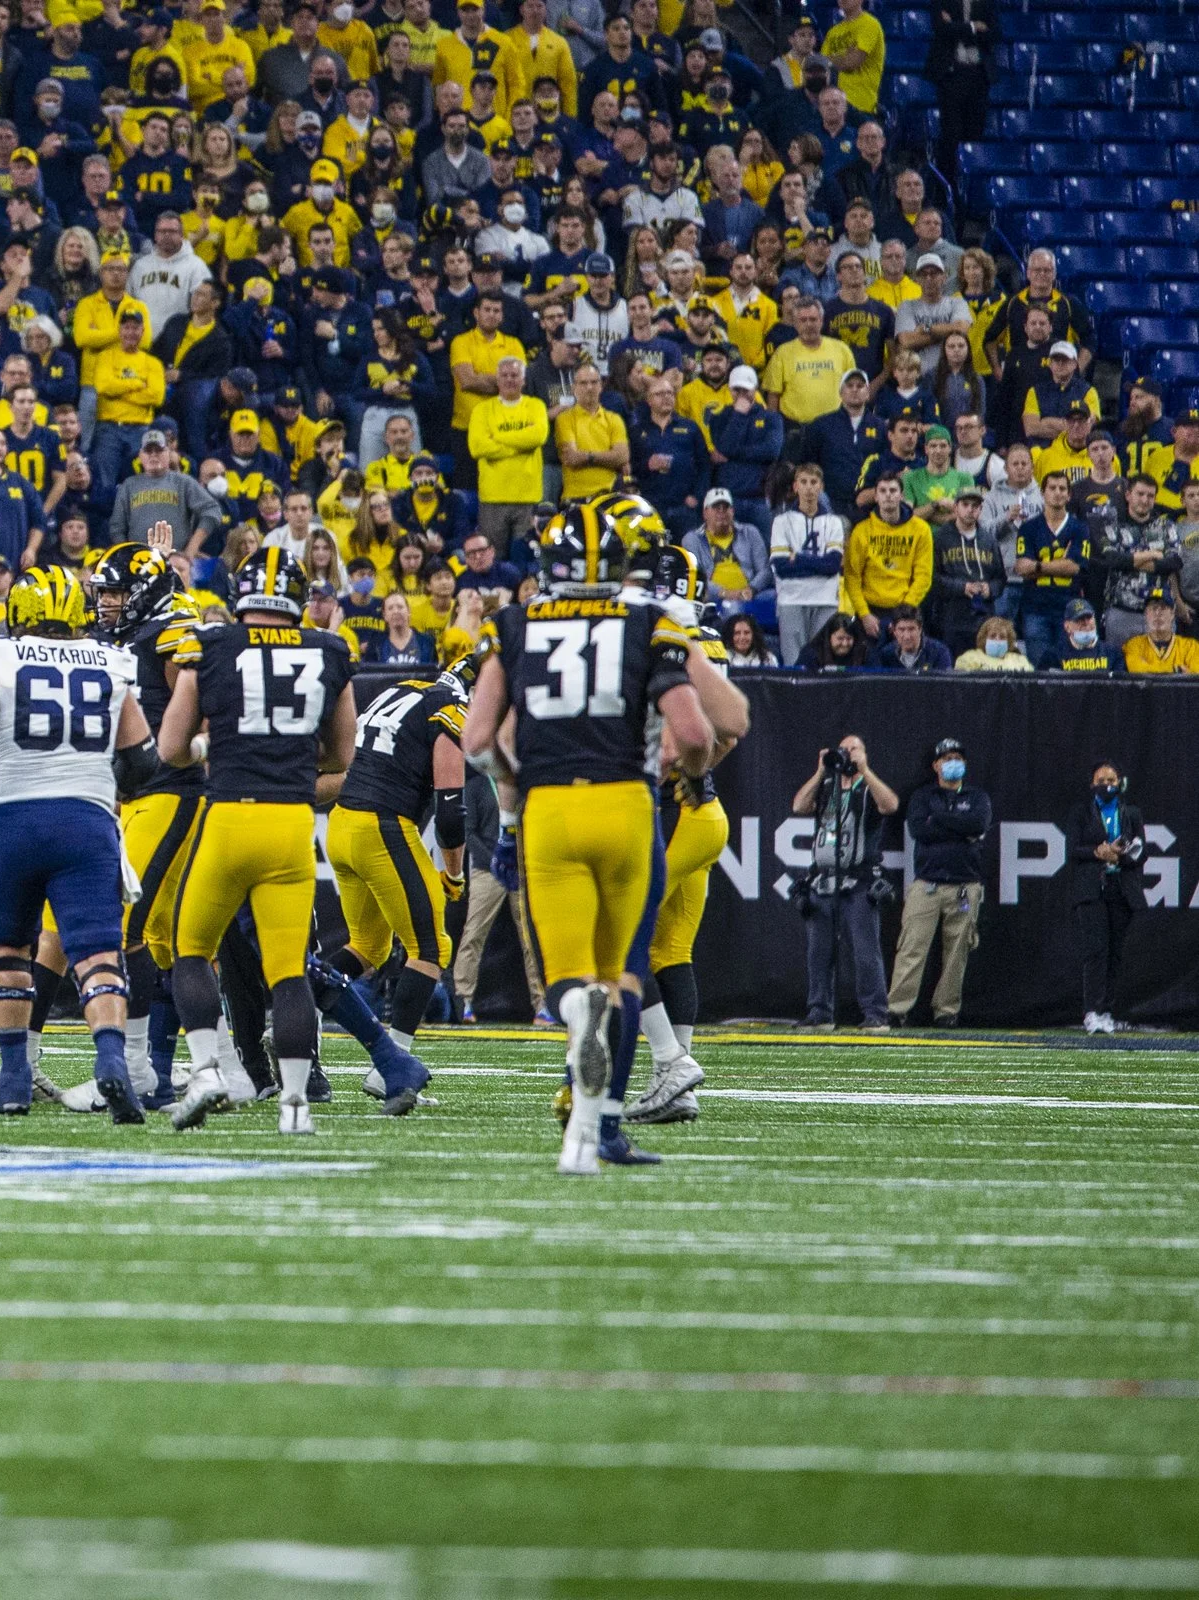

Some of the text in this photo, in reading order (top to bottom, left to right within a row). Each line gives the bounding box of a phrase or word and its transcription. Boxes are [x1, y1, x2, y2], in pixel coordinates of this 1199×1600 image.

[140, 271, 181, 289] IOWA
[829, 310, 881, 331] MICHIGAN
[226, 469, 265, 500] M
[130, 488, 179, 510] MICHIGAN
[869, 534, 915, 547] MICHIGAN
[255, 568, 289, 594] 13
[571, 558, 609, 582] 31
[675, 577, 705, 600] 97
[527, 598, 630, 620] CAMPBELL
[248, 627, 303, 646] EVANS
[14, 643, 108, 667] VASTARDIS
[1062, 656, 1108, 671] MICHIGAN
[525, 617, 627, 720] 31
[235, 647, 326, 736] 13
[13, 664, 113, 753] 68
[355, 687, 424, 757] 44
